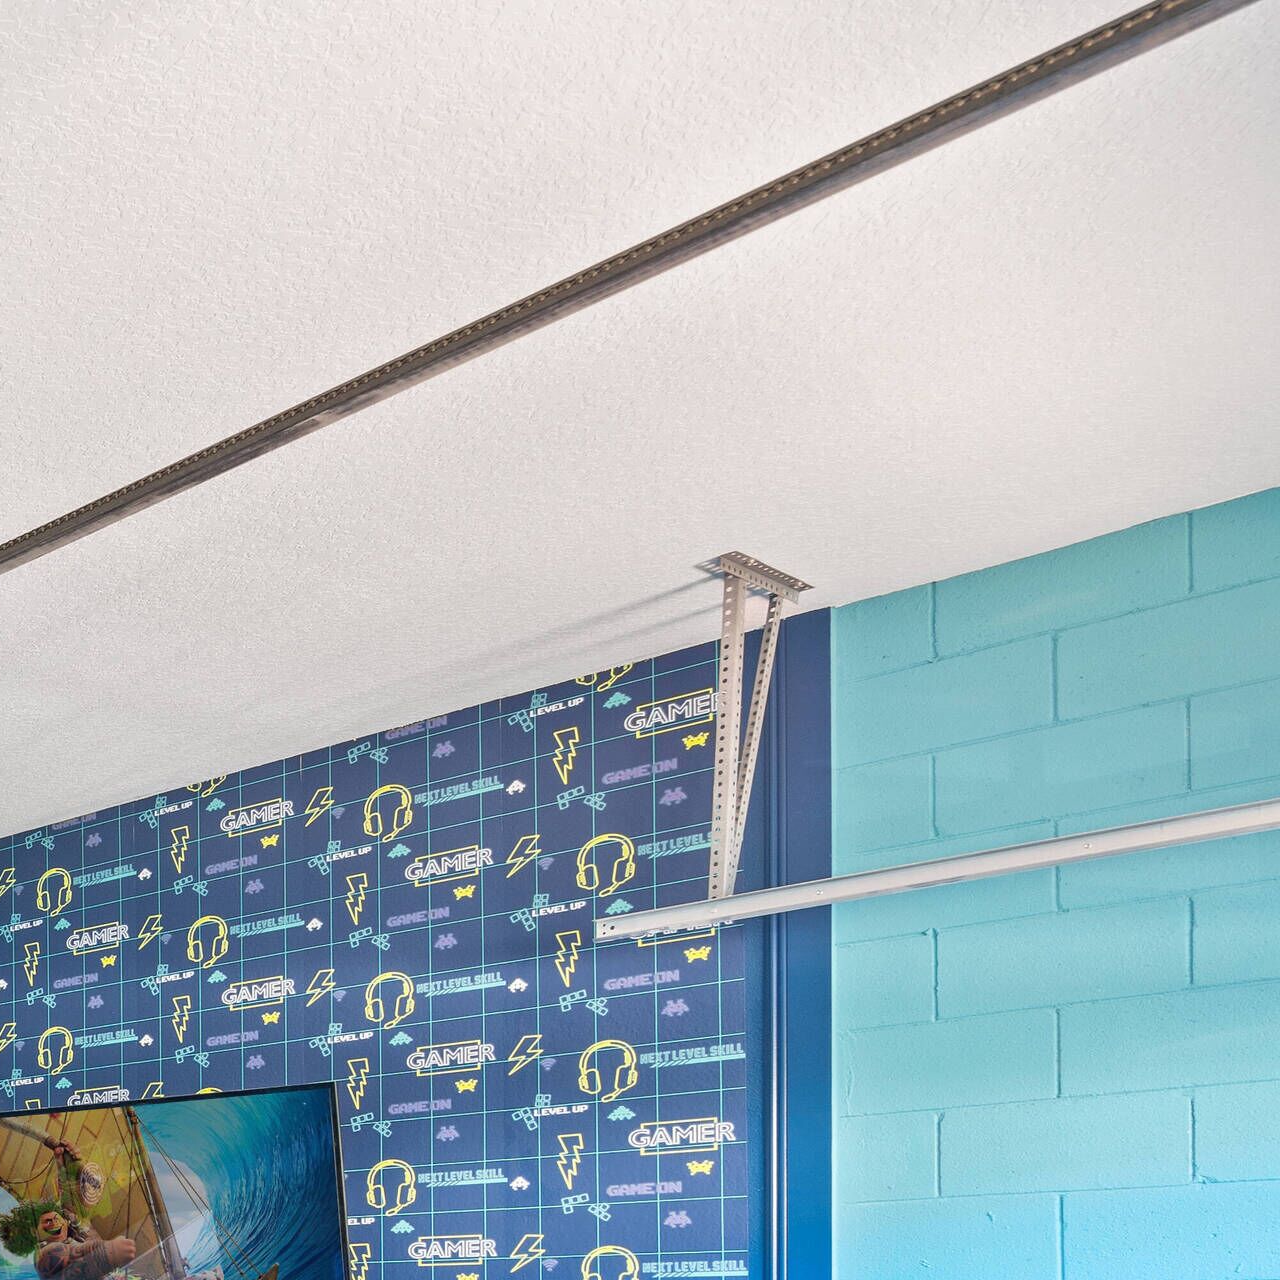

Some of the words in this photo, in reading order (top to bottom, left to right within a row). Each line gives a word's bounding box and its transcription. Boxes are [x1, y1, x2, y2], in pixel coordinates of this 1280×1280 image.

[530, 702, 566, 716] LEVEL
[567, 696, 583, 707] UP
[414, 789, 439, 804] NEXT
[440, 781, 470, 797] LEVEL
[472, 774, 500, 790] SKILL
[154, 804, 180, 815] LEVEL
[181, 800, 192, 809] UP
[220, 800, 294, 831] GAMER
[326, 849, 356, 861] LEVEL
[358, 846, 371, 854] UP
[637, 839, 668, 855] NEXT
[669, 832, 706, 848] LEVEL
[404, 848, 493, 880] GAMER
[532, 904, 568, 916] LEVEL
[570, 900, 586, 910] UP
[66, 924, 129, 949] GAMER
[156, 973, 182, 983] LEVEL
[416, 981, 441, 993] NEXT
[442, 976, 472, 989] LEVEL
[474, 971, 502, 984] SKILL
[221, 979, 295, 1004] GAMER
[327, 1033, 358, 1043] LEVEL
[359, 1031, 372, 1039] UP
[406, 1043, 496, 1069] GAMER
[639, 1051, 670, 1064] NEXT
[671, 1046, 708, 1060] LEVEL
[710, 1042, 744, 1056] SKILL
[11, 1078, 33, 1086] LEVEL
[534, 1106, 570, 1116] LEVEL
[572, 1104, 588, 1113] UP
[627, 1121, 736, 1148] GAMER
[417, 1172, 443, 1183] NEXT
[444, 1170, 474, 1181] LEVEL
[476, 1168, 504, 1179] SKILL
[407, 1238, 497, 1259] GAMER
[642, 1262, 673, 1273] NEXT
[674, 1261, 711, 1272] LEVEL
[713, 1260, 747, 1271] SKILL
